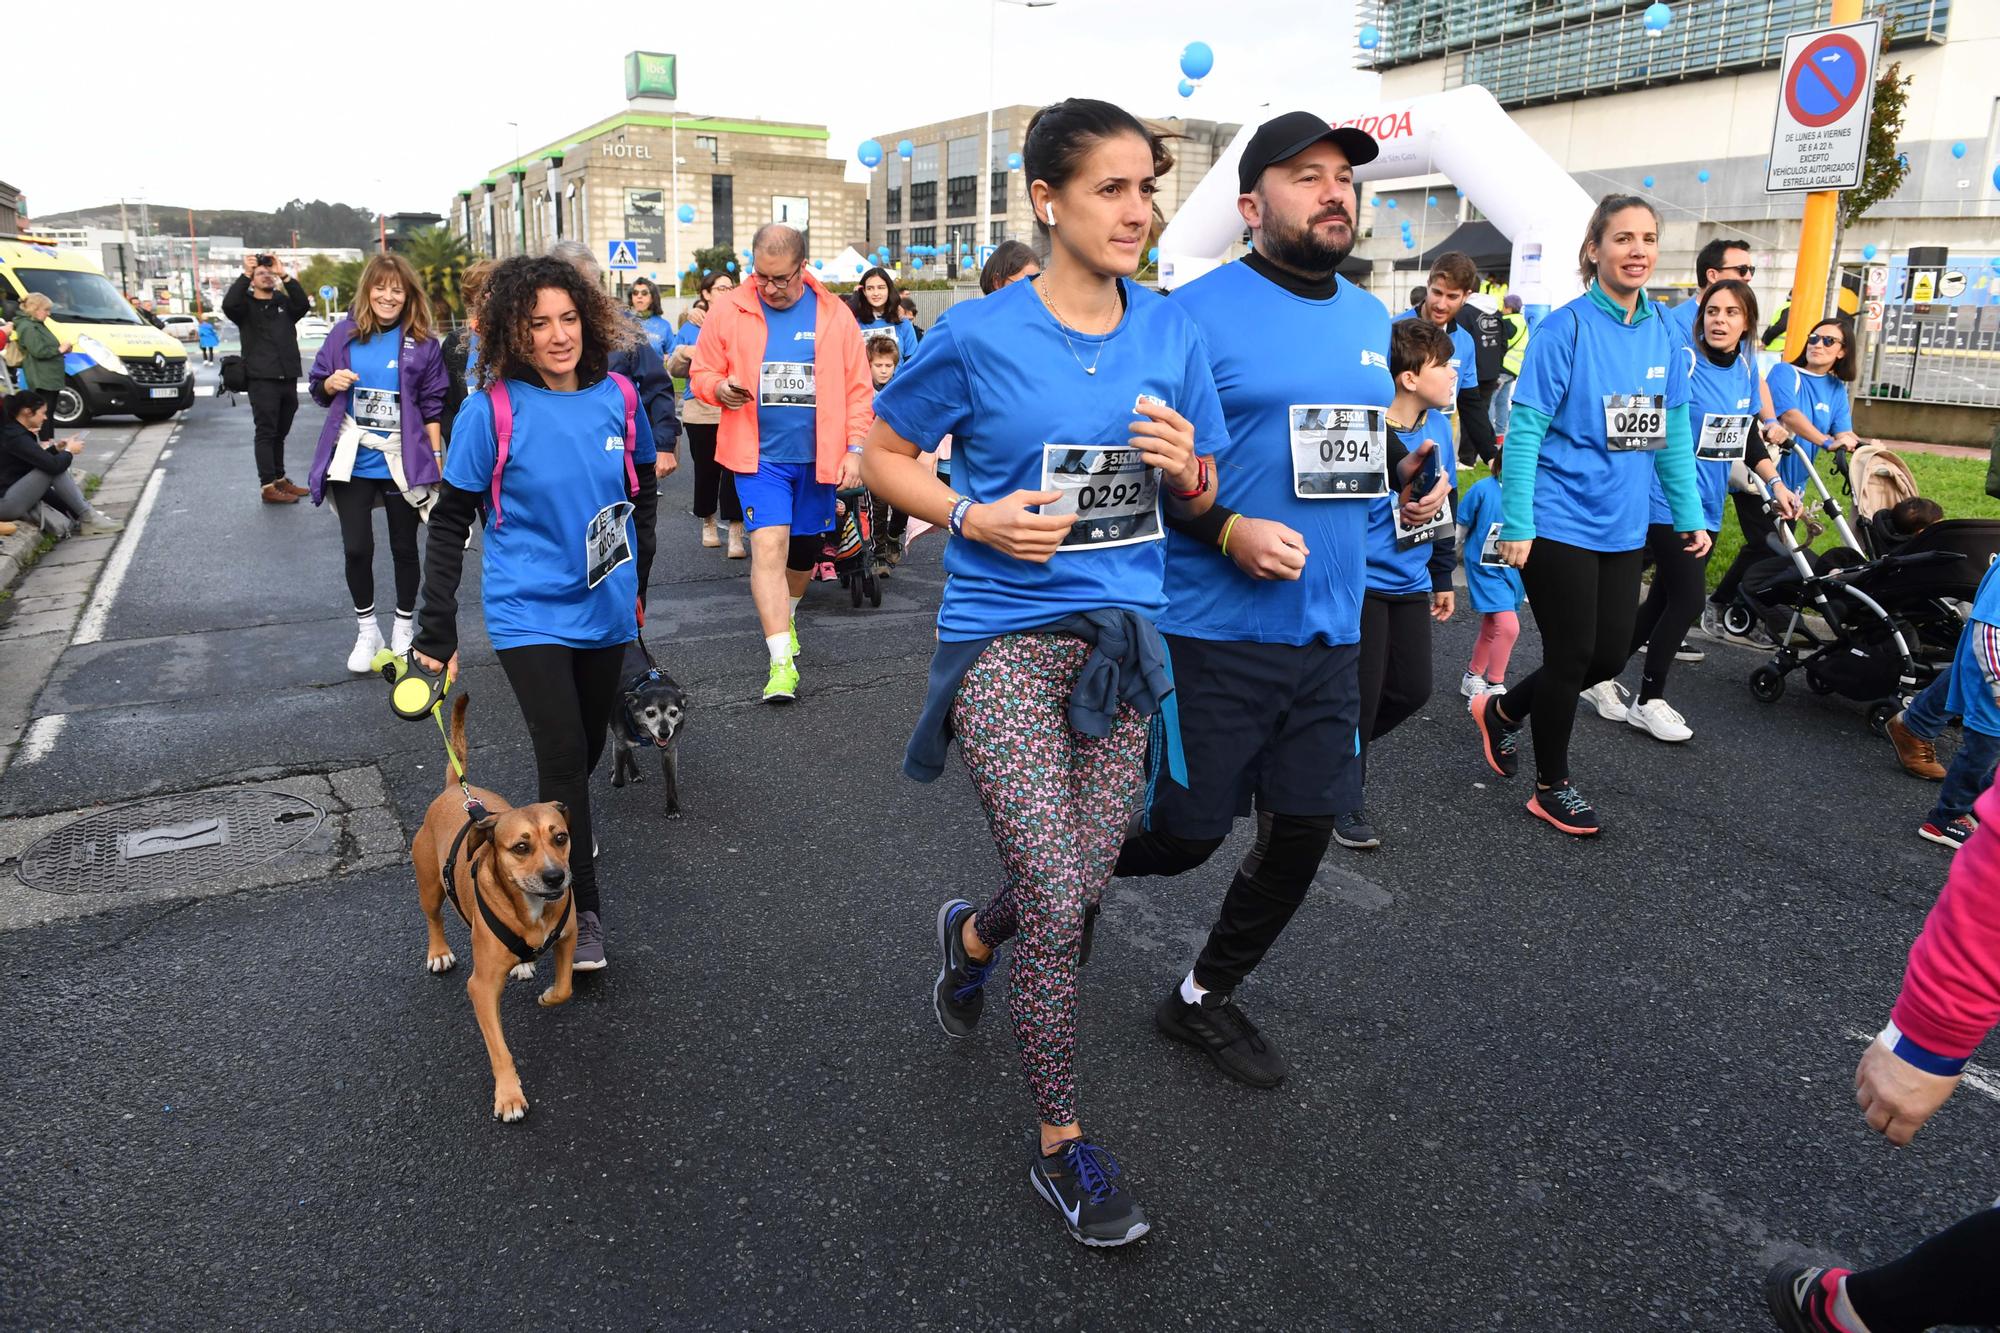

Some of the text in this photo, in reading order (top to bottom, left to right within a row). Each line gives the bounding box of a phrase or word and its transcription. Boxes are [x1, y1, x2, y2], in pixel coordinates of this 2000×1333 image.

[1785, 128, 1852, 142] DE LUNES A VIERNES
[1798, 144, 1807, 152] DE
[1813, 143, 1818, 151] A
[1819, 142, 1827, 150] 22
[1800, 153, 1830, 163] EXCEPTO
[1809, 163, 1855, 173] AUTORIZADOS
[1783, 175, 1842, 187] ESTRELLA GALICIA
[774, 378, 805, 389] 0190
[366, 403, 393, 416] 0291
[1340, 411, 1365, 422] 5KM
[1614, 413, 1660, 433] 0269
[1715, 432, 1738, 443] 0185
[1319, 440, 1370, 462] 0294
[1111, 452, 1142, 465] 5KM
[1077, 482, 1142, 511] 0292
